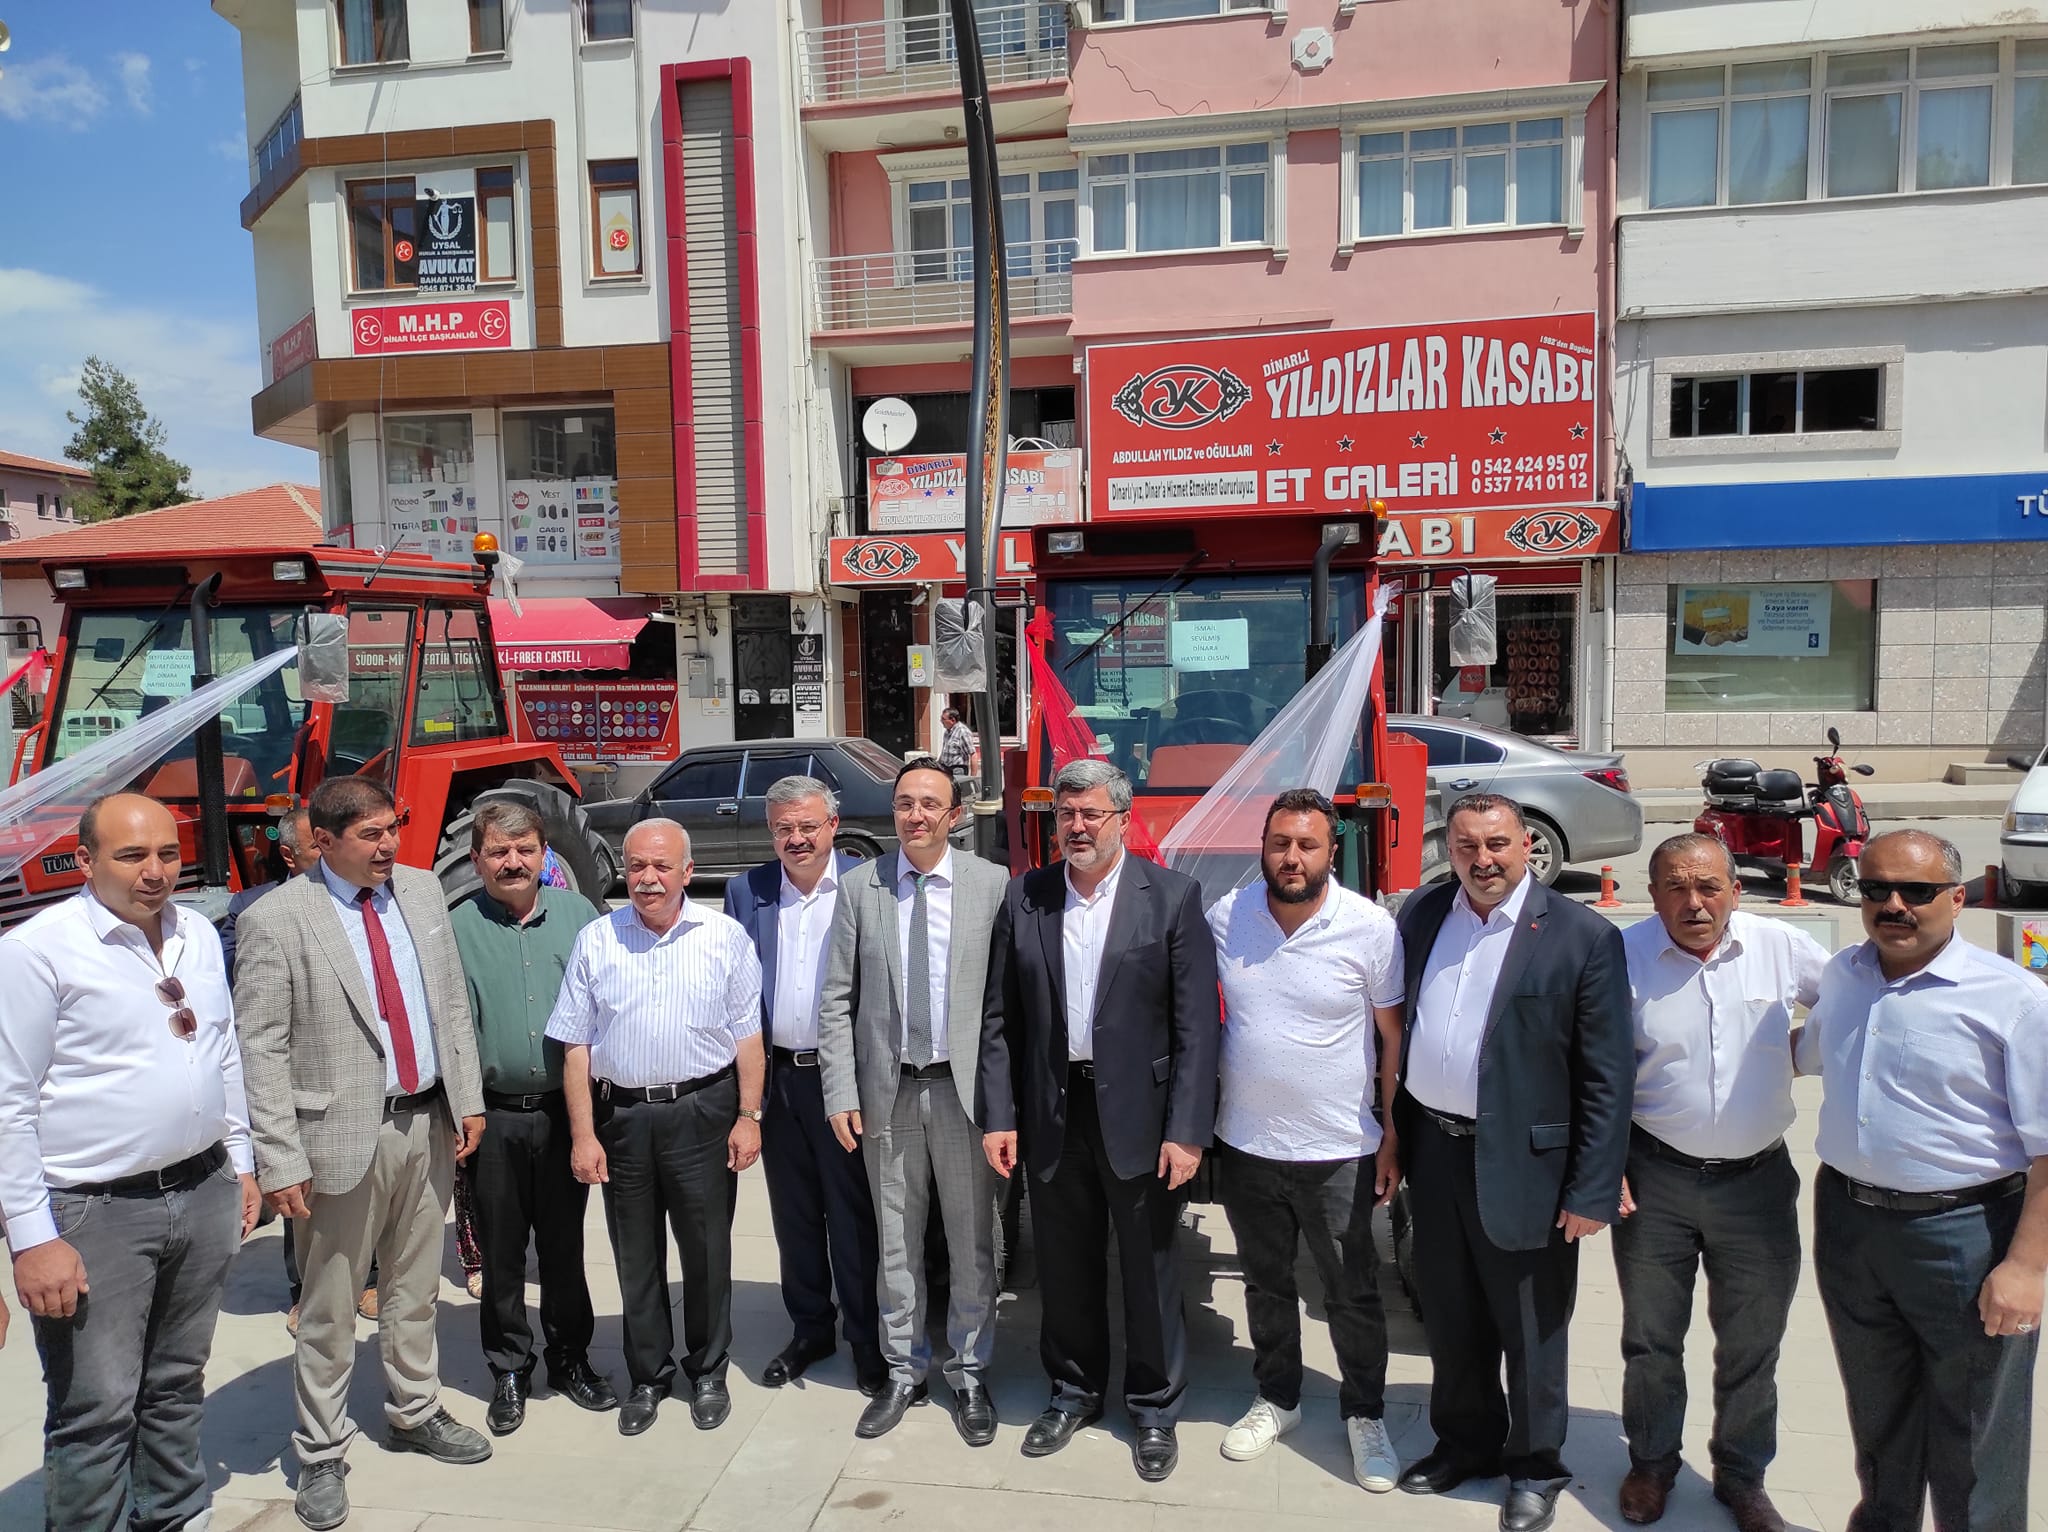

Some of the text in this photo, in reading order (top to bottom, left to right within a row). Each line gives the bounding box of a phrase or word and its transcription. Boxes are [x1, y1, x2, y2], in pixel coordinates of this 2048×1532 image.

[432, 241, 461, 249] UYSAL
[418, 258, 475, 275] AVUKAT
[420, 275, 475, 284] BAHAR UYSAL
[456, 283, 466, 291] 30
[399, 312, 464, 333] M.H.P
[383, 330, 478, 344] DİNAR İLÇE BAŞKANLIĞI
[1262, 349, 1311, 378] DİNARLI
[1265, 335, 1593, 419] YILDIZLAR KASABI
[1112, 443, 1253, 464] ABDULLAH YILDIZ ve OĞULLARI
[906, 459, 954, 475] DİNARLI
[1471, 453, 1588, 475] 0 542 424 95 07
[910, 468, 966, 490] YILDIZL
[1266, 453, 1459, 503] ET GALERİ
[1471, 472, 1588, 494] 0 537 741 01 12
[1189, 479, 1218, 497] Etmekten
[392, 523, 420, 531] TIGRA
[545, 650, 582, 663] CASTELL
[794, 664, 823, 673] AVUKAT
